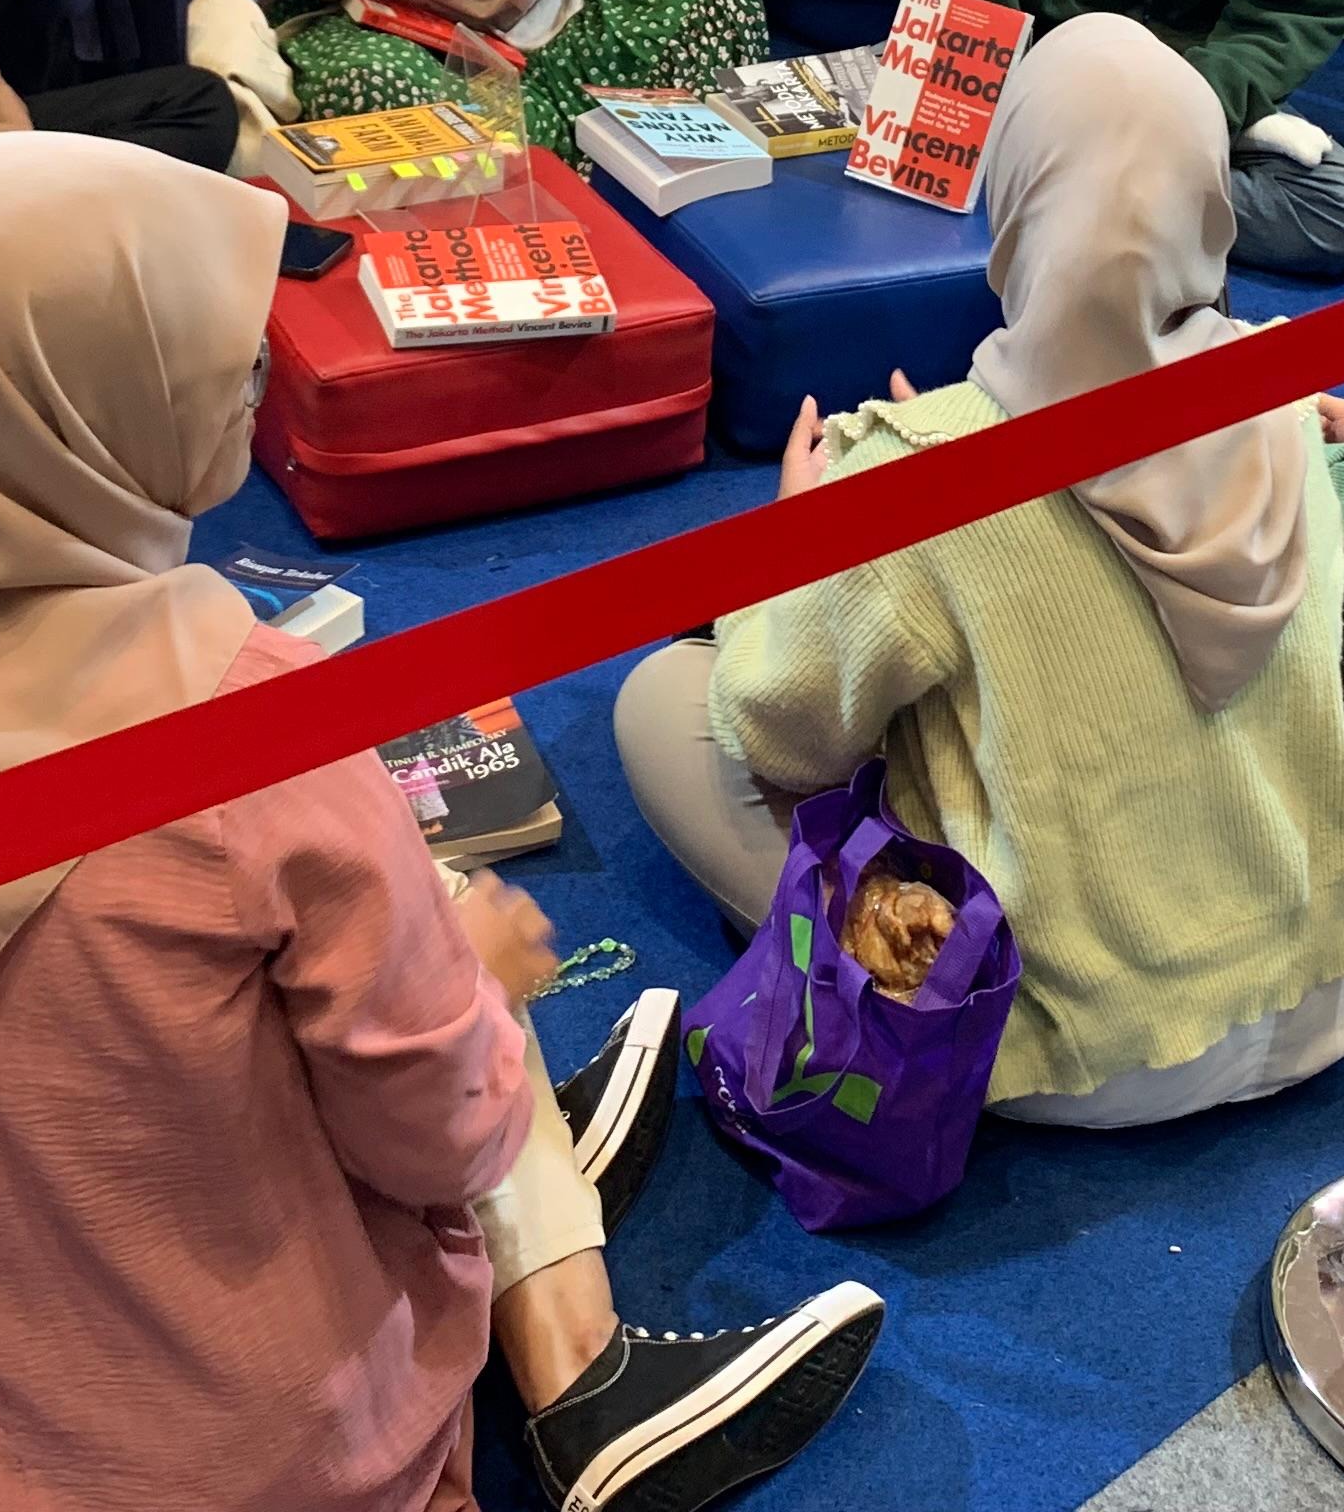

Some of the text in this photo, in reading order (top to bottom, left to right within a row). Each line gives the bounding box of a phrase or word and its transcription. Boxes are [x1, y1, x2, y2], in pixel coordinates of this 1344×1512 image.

[892, 7, 1014, 68] Jakarta
[880, 40, 1007, 103] Method
[630, 120, 731, 133] NATIONS
[641, 111, 693, 121] FAIL
[665, 132, 724, 144] WHY
[866, 105, 980, 169] Vincent
[849, 140, 950, 199] Bevins
[514, 225, 572, 318] Vincent
[560, 234, 612, 315] Bevins
[396, 294, 418, 321] The
[392, 742, 515, 784] Candik Ala
[465, 753, 520, 779] 1965
